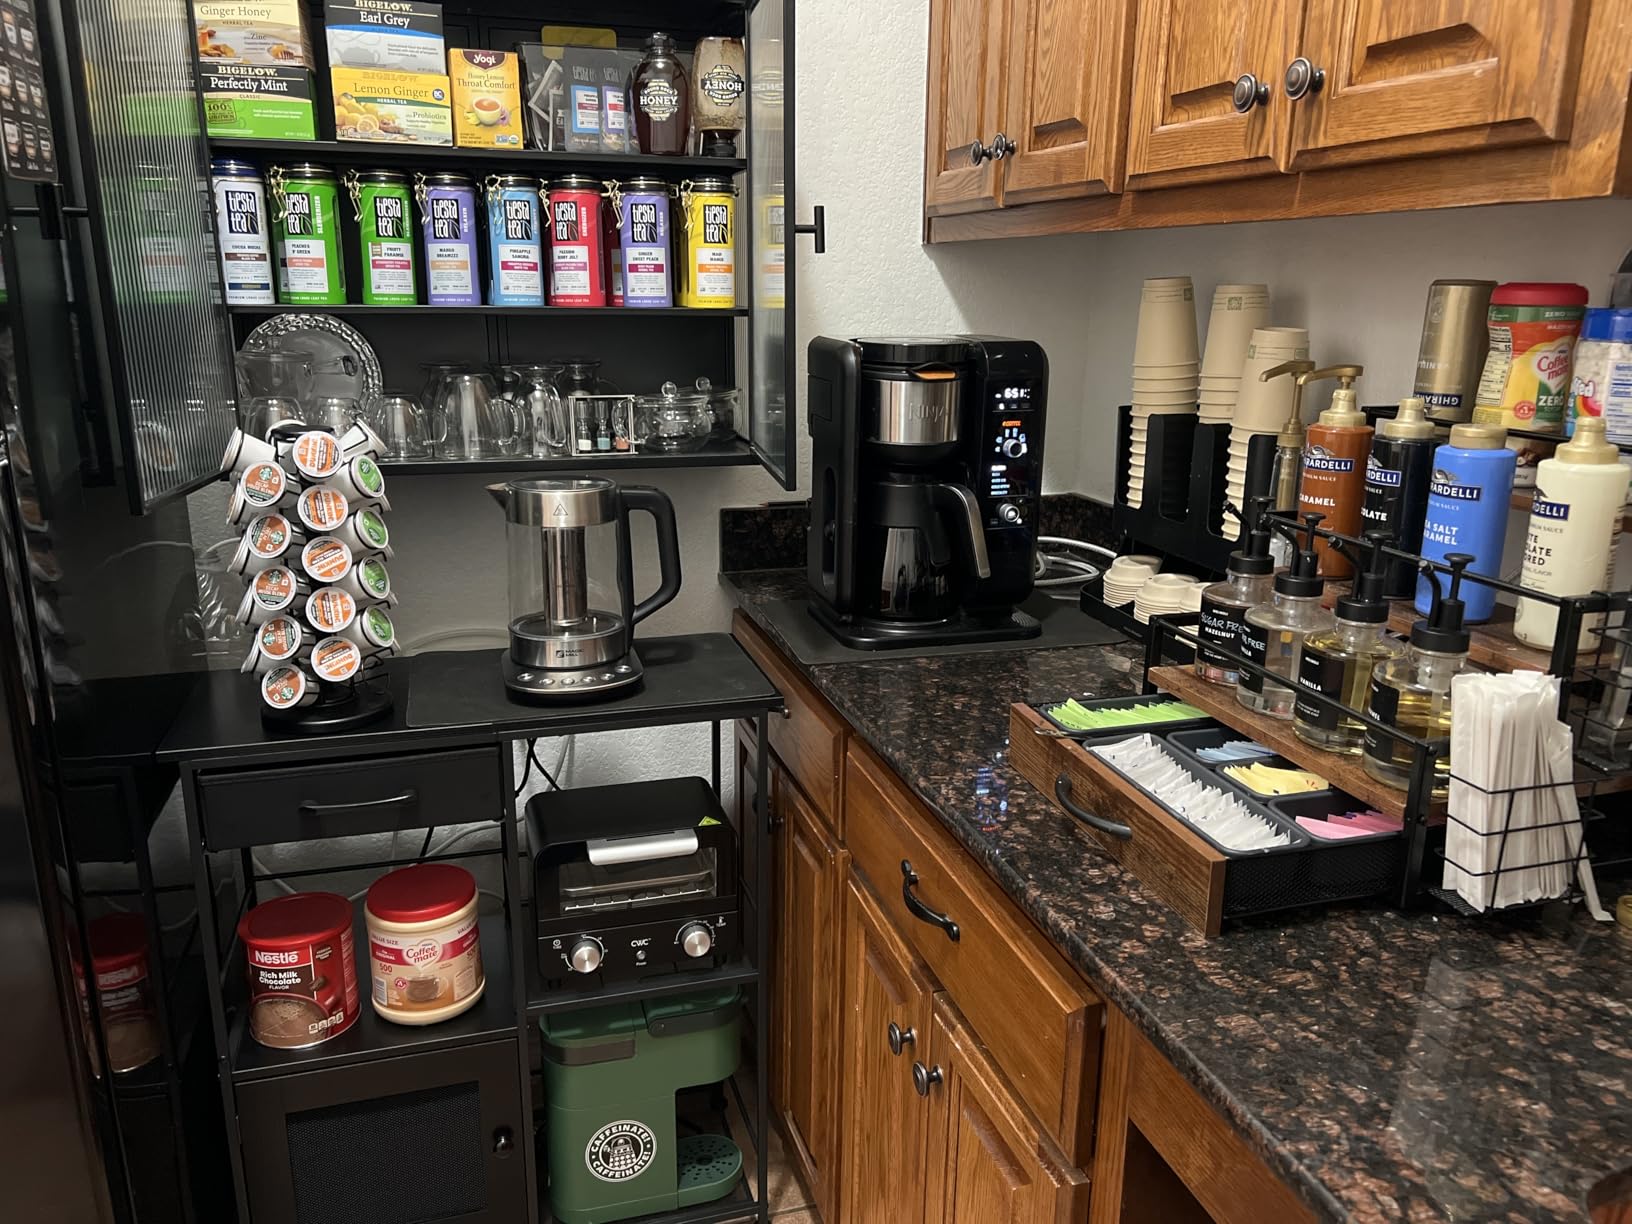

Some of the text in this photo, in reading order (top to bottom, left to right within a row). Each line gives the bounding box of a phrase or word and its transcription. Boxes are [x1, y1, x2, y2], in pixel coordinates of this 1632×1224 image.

[200, 6, 272, 19] Ginger Honey
[360, 12, 410, 28] Earl Grey
[210, 77, 288, 92] Perfectly Mint
[354, 83, 390, 95] Lemon
[393, 86, 429, 98] Ginger
[457, 78, 515, 89] Throat Comfort
[704, 81, 742, 91] HONEY
[640, 96, 678, 105] HONEY
[413, 112, 446, 120] Probiotics
[228, 192, 256, 213] tiesta
[376, 198, 401, 218] tiesta
[433, 200, 458, 219] tiesta
[506, 201, 530, 220] tiesta
[633, 205, 654, 223] tiesta
[705, 206, 726, 224] tiesta
[230, 213, 248, 232] tea
[288, 214, 300, 234] tea
[378, 218, 393, 237] tea
[435, 219, 449, 238] tea
[508, 220, 522, 238] tea
[556, 221, 568, 240] tea
[634, 223, 646, 241] tea
[706, 224, 719, 242] tea
[1538, 395, 1565, 406] ZERO
[1433, 523, 1458, 536] SALT
[1201, 612, 1243, 633] SUGAR FRE
[1205, 627, 1235, 639] HAZELNUT
[1247, 638, 1266, 651] FREE
[1300, 677, 1322, 691] VANILLA
[630, 939, 649, 948] CWC
[255, 950, 299, 964] Nestlé
[376, 952, 395, 960] ORIGINAL
[406, 945, 436, 958] Coffee
[414, 951, 438, 963] mate
[380, 963, 392, 972] 500
[591, 1124, 651, 1152] CAFFEINATE!
[593, 1152, 651, 1178] CAFFEINATE!
